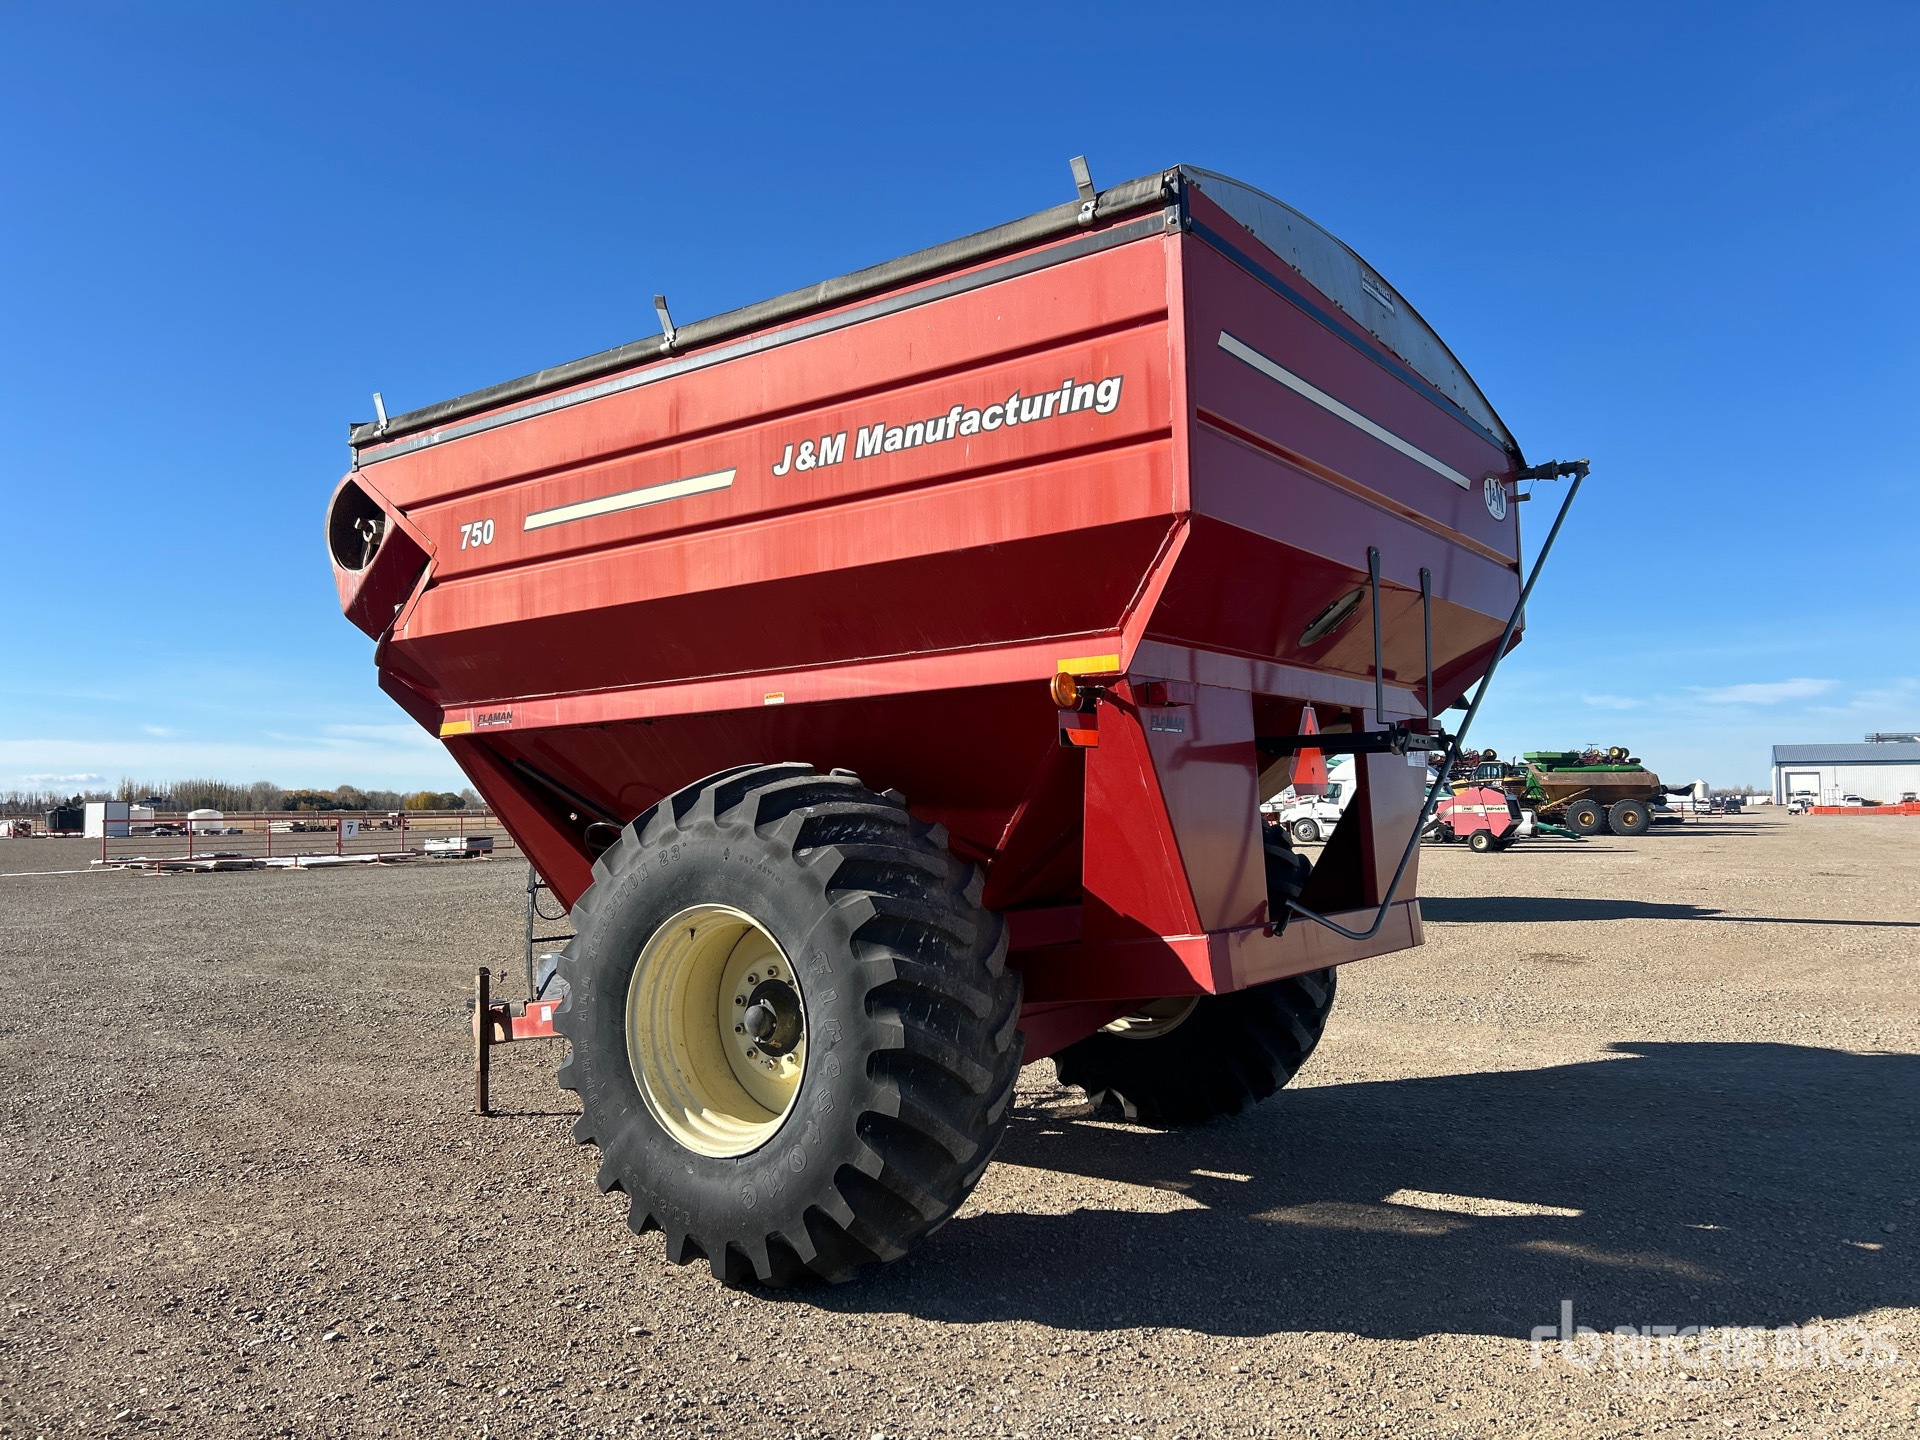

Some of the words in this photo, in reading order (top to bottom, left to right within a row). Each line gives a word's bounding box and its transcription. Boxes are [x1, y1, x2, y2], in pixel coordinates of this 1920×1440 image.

[773, 430, 848, 477] J&M
[854, 375, 1125, 460] Manufacturing
[460, 518, 496, 551] 750
[477, 711, 514, 723] FLAMAN
[347, 824, 354, 835] 7
[577, 976, 592, 1022] ALL
[586, 862, 650, 961] TRACTION
